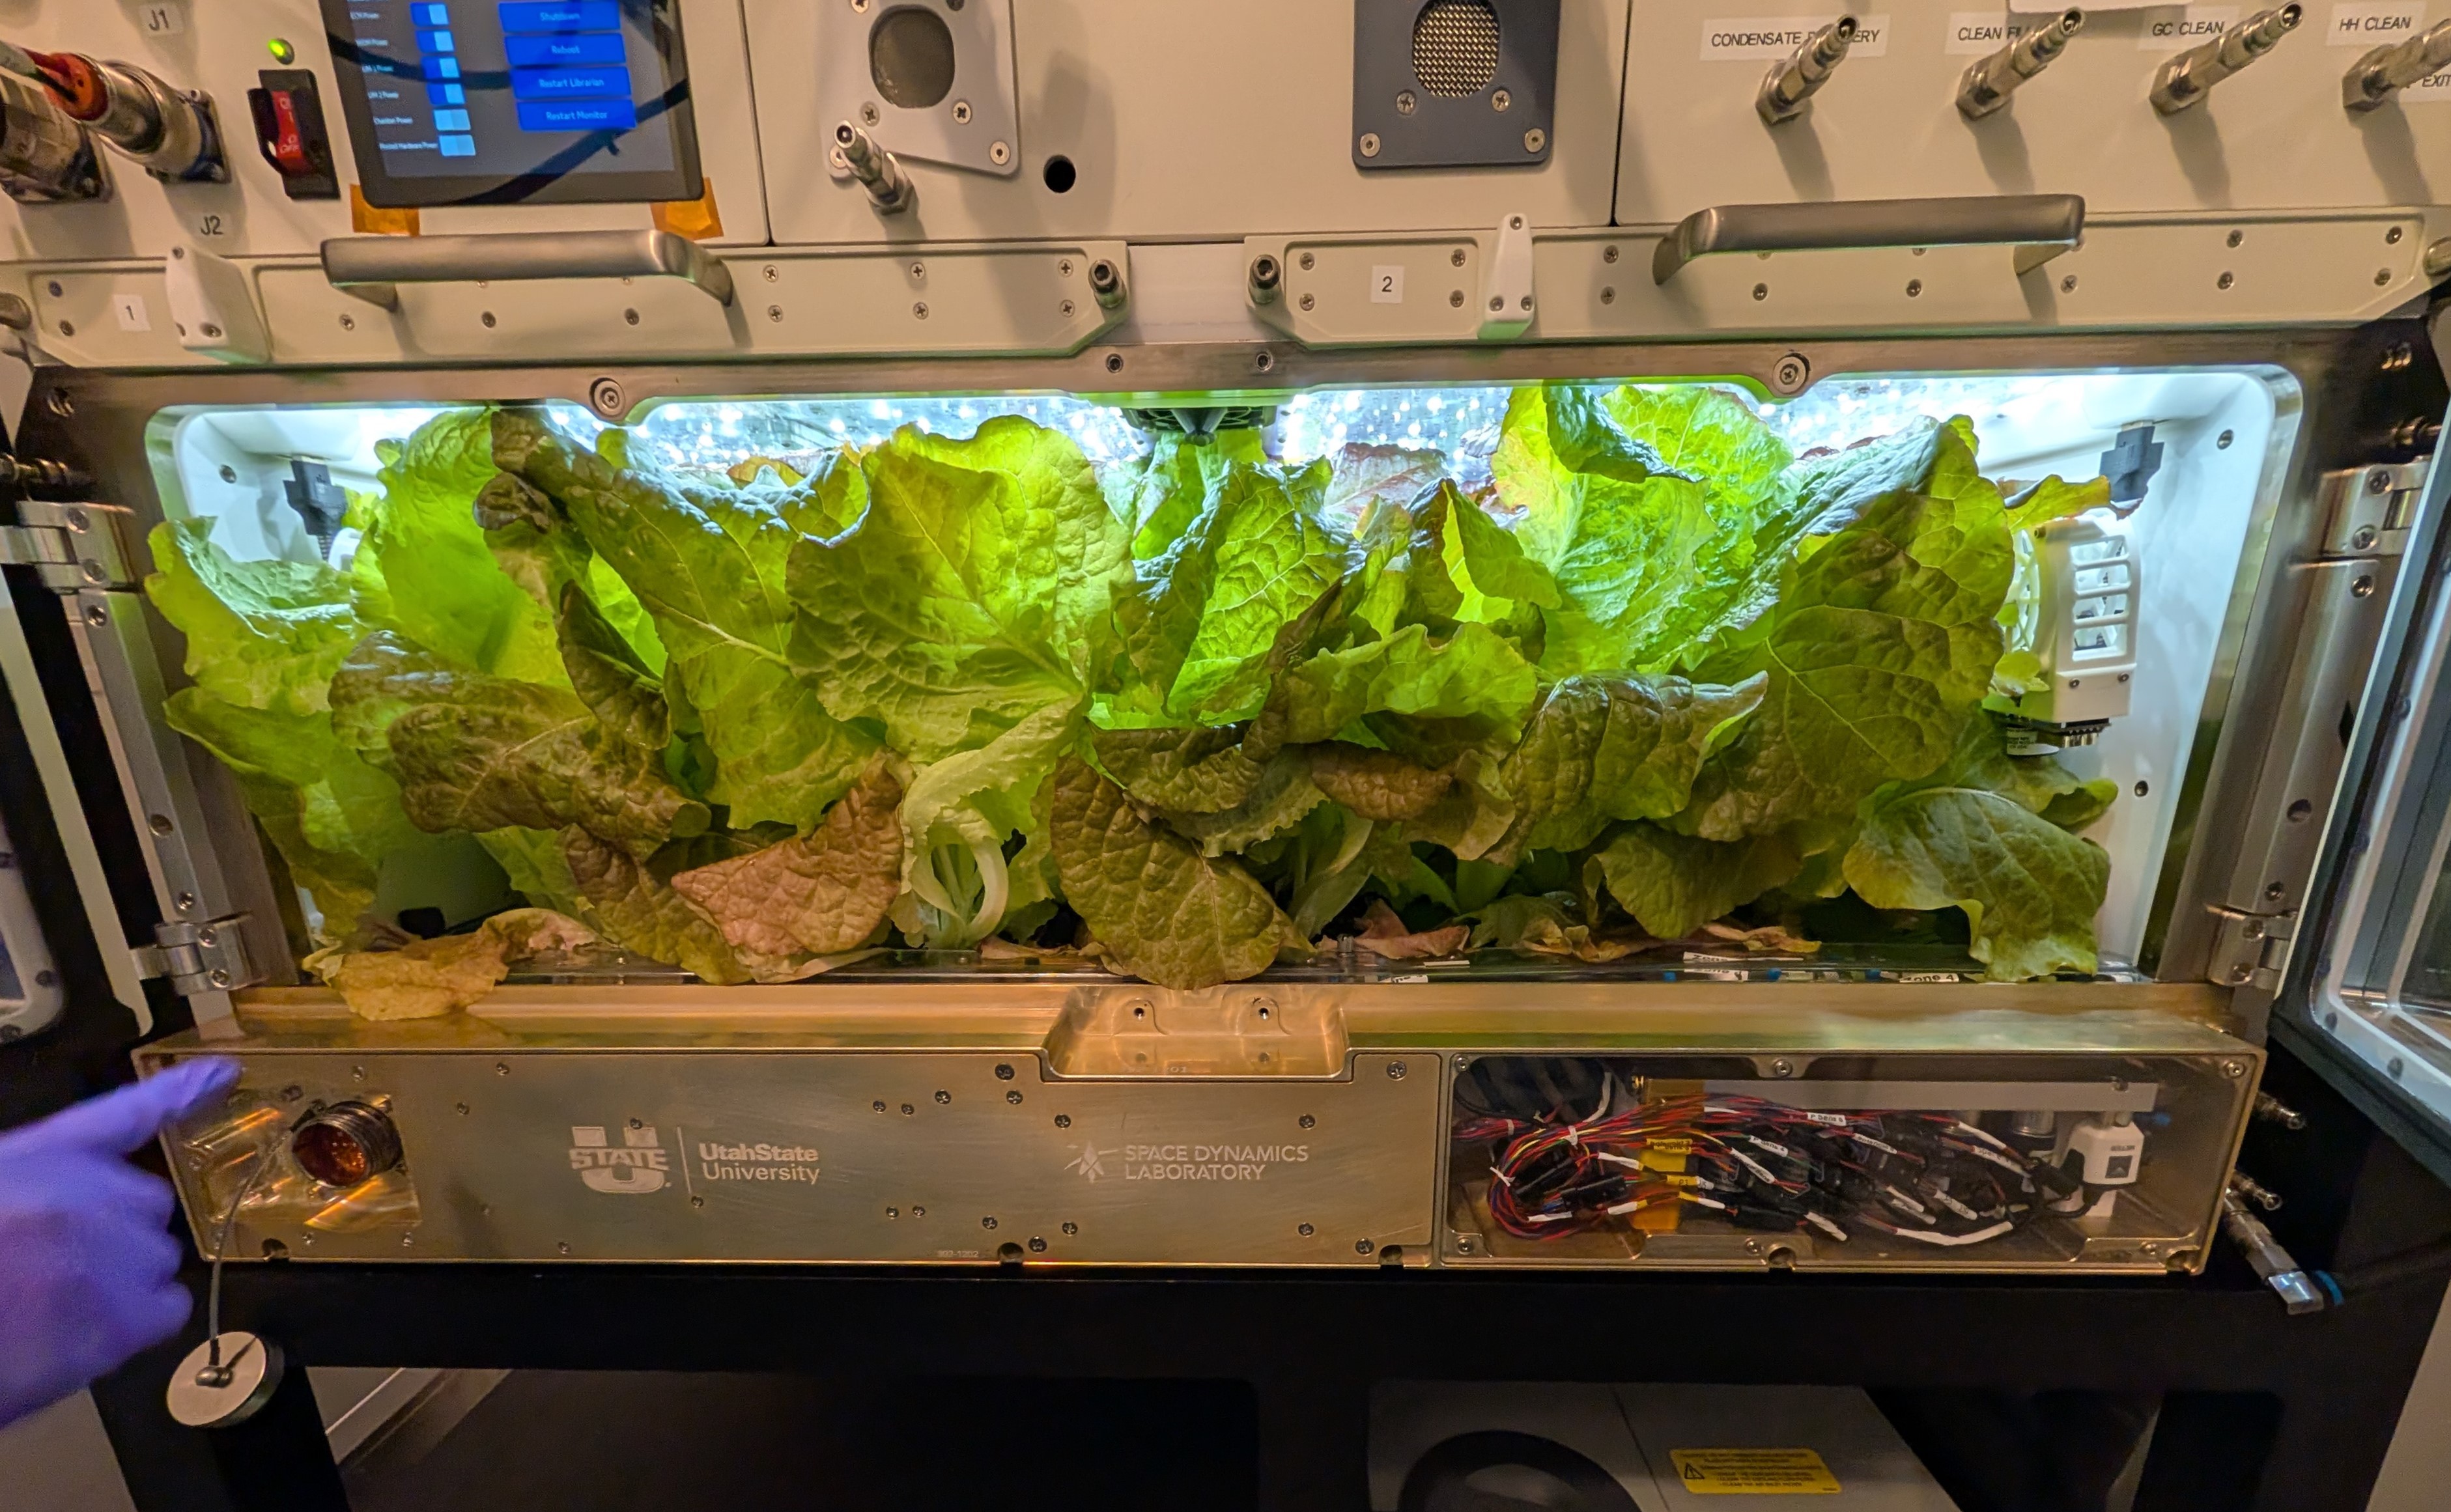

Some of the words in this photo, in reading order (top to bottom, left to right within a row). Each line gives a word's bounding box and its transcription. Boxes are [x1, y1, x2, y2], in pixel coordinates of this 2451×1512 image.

[149, 8, 169, 31] J1
[2340, 18, 2360, 31] HH
[2365, 17, 2411, 31] CLEAN
[1958, 27, 2002, 40] CLEAN
[2153, 22, 2173, 36] GC
[2179, 21, 2224, 35] CLEAN
[1712, 31, 1801, 47] CONDENSATE
[539, 79, 567, 87] Restart
[569, 78, 604, 87] Librarian
[576, 111, 607, 119] Monitor
[200, 216, 223, 235] J2
[1381, 275, 1393, 292] 2
[126, 305, 134, 320] 1
[569, 1148, 670, 1171] STATE
[699, 1143, 819, 1162] UtahState
[1126, 1145, 1188, 1161] SPACE
[1195, 1145, 1309, 1162] DYNAMICS
[703, 1162, 820, 1185] University
[1126, 1164, 1266, 1180] LABORATORY
